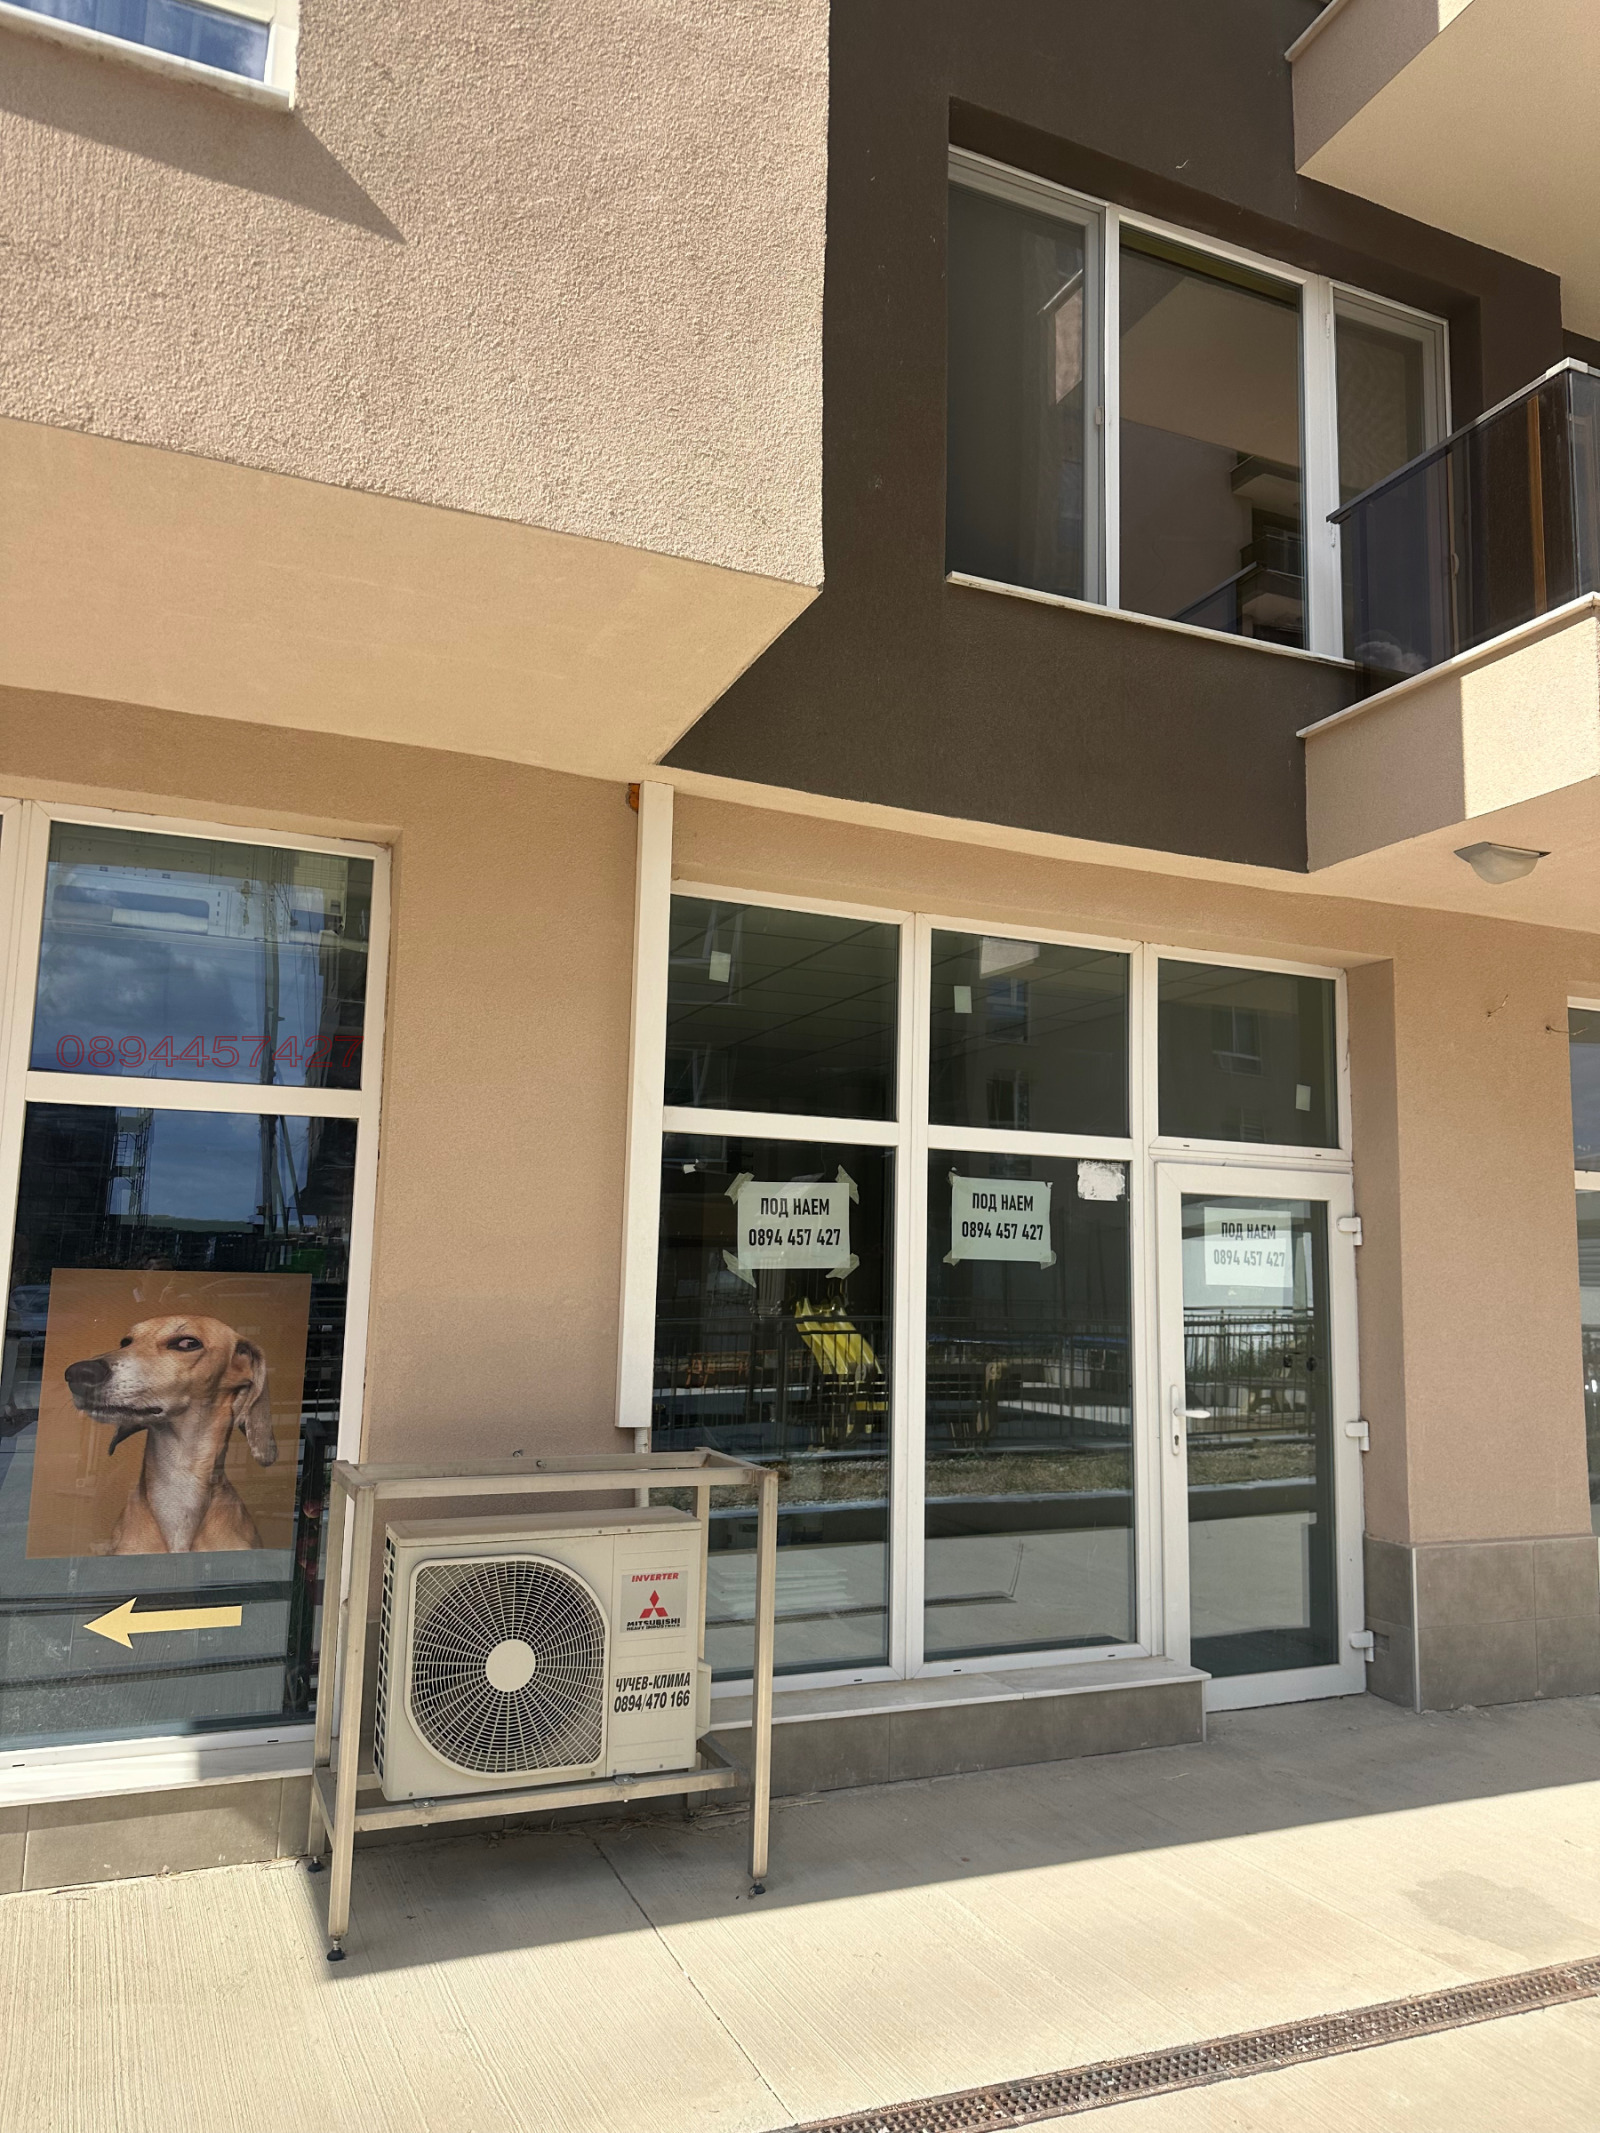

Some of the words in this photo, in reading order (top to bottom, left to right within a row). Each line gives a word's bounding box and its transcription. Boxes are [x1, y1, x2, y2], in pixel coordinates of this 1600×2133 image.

[760, 1197, 789, 1218] ПОД
[793, 1198, 830, 1216] НАЕМ
[972, 1192, 997, 1213] ПОД
[1001, 1194, 1034, 1212] НАЕМ
[748, 1227, 783, 1247] 0894
[787, 1228, 811, 1247] 457
[816, 1228, 841, 1246] 427
[961, 1221, 992, 1239] 0894
[995, 1222, 1018, 1240] 457
[1021, 1224, 1044, 1241] 427
[1221, 1222, 1244, 1240] ПОД
[1246, 1224, 1276, 1240] НАЕМ
[1213, 1249, 1240, 1266] 0894
[1243, 1250, 1263, 1267] 457
[1266, 1251, 1286, 1268] 427
[631, 1572, 680, 1583] INVERTER
[626, 1617, 681, 1627] MITSUBISHI
[615, 1671, 691, 1693] ЧУЧЕВ-КЛИМА
[613, 1691, 668, 1713] 0894/470
[670, 1689, 690, 1708] 166
